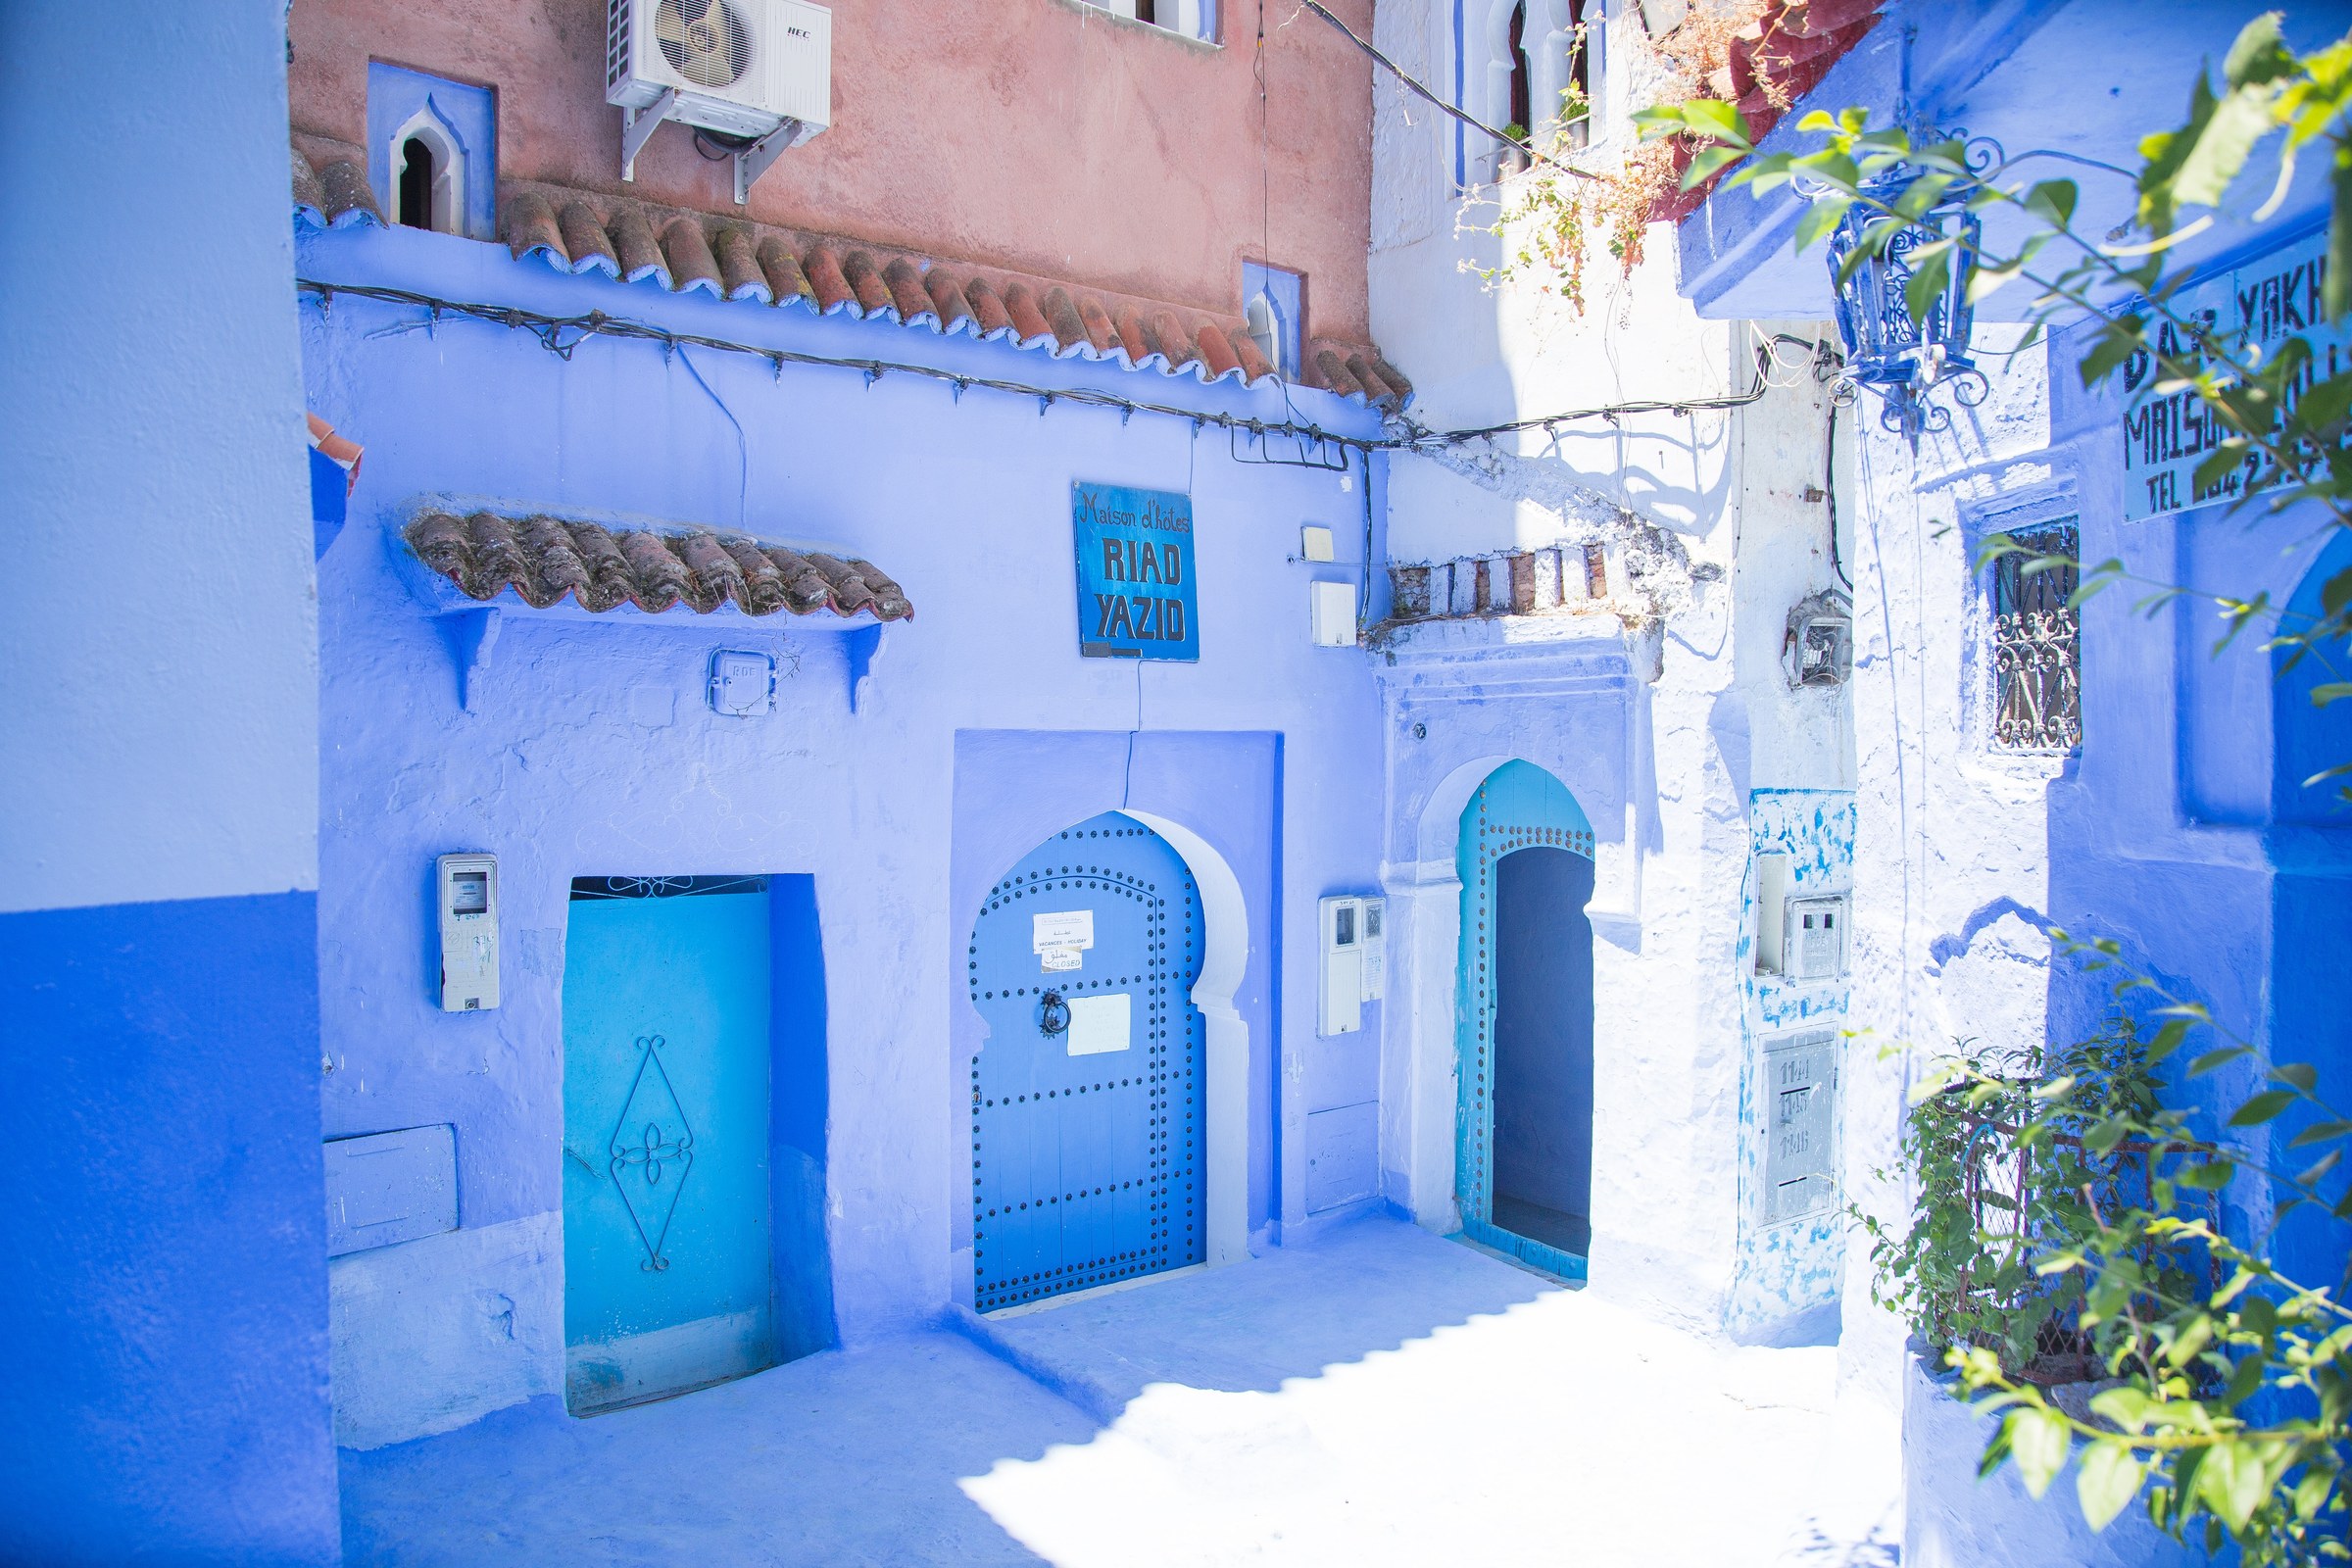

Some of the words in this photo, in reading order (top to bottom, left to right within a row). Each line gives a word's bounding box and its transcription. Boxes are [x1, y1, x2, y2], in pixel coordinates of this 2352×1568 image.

[787, 26, 811, 39] HEC
[1080, 491, 1137, 526] Maison
[1141, 498, 1191, 534] d'hôtes
[2145, 469, 2181, 515] TEL
[1102, 537, 1182, 586] RIAD
[1093, 593, 1186, 642] YAZID
[1052, 959, 1081, 968] CLOSED
